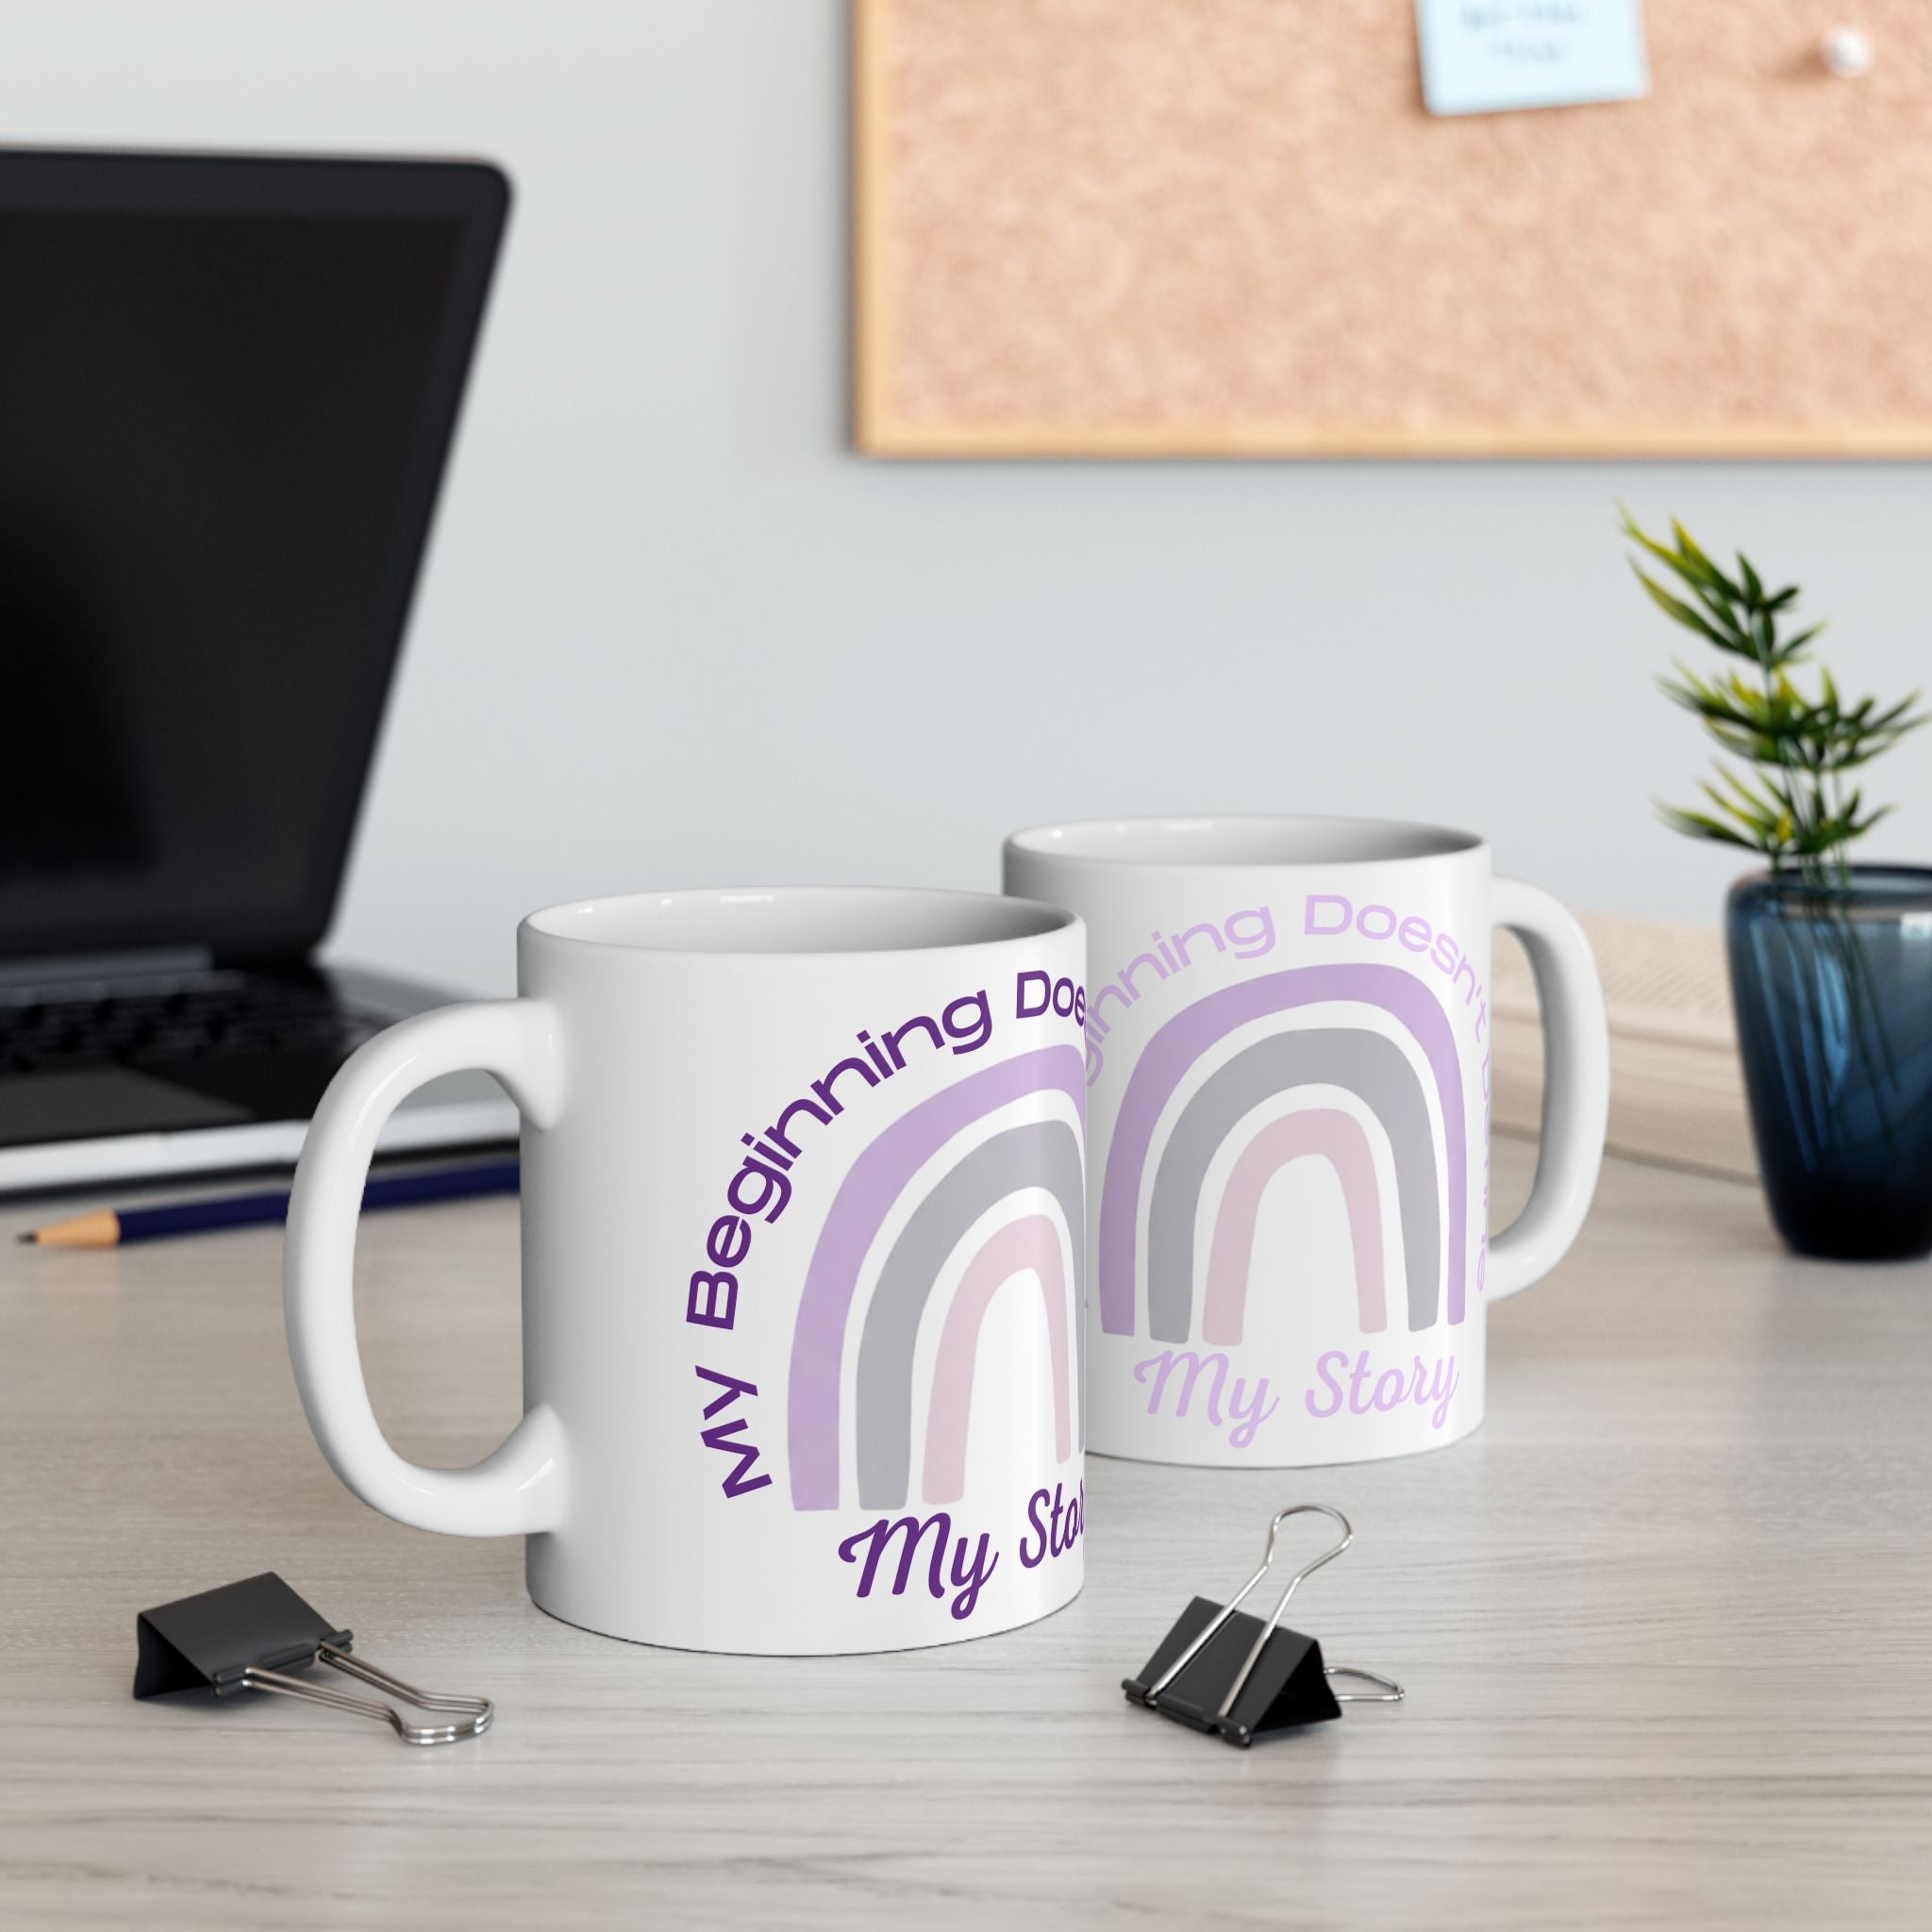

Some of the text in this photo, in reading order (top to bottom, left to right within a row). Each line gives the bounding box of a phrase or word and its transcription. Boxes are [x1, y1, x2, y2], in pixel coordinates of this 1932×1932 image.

[1305, 894, 1486, 1044] Doesn't
[686, 970, 1086, 1499] My Beginning Doe
[1134, 1350, 1460, 1448] My Story
[838, 1477, 1084, 1620] My Stor
